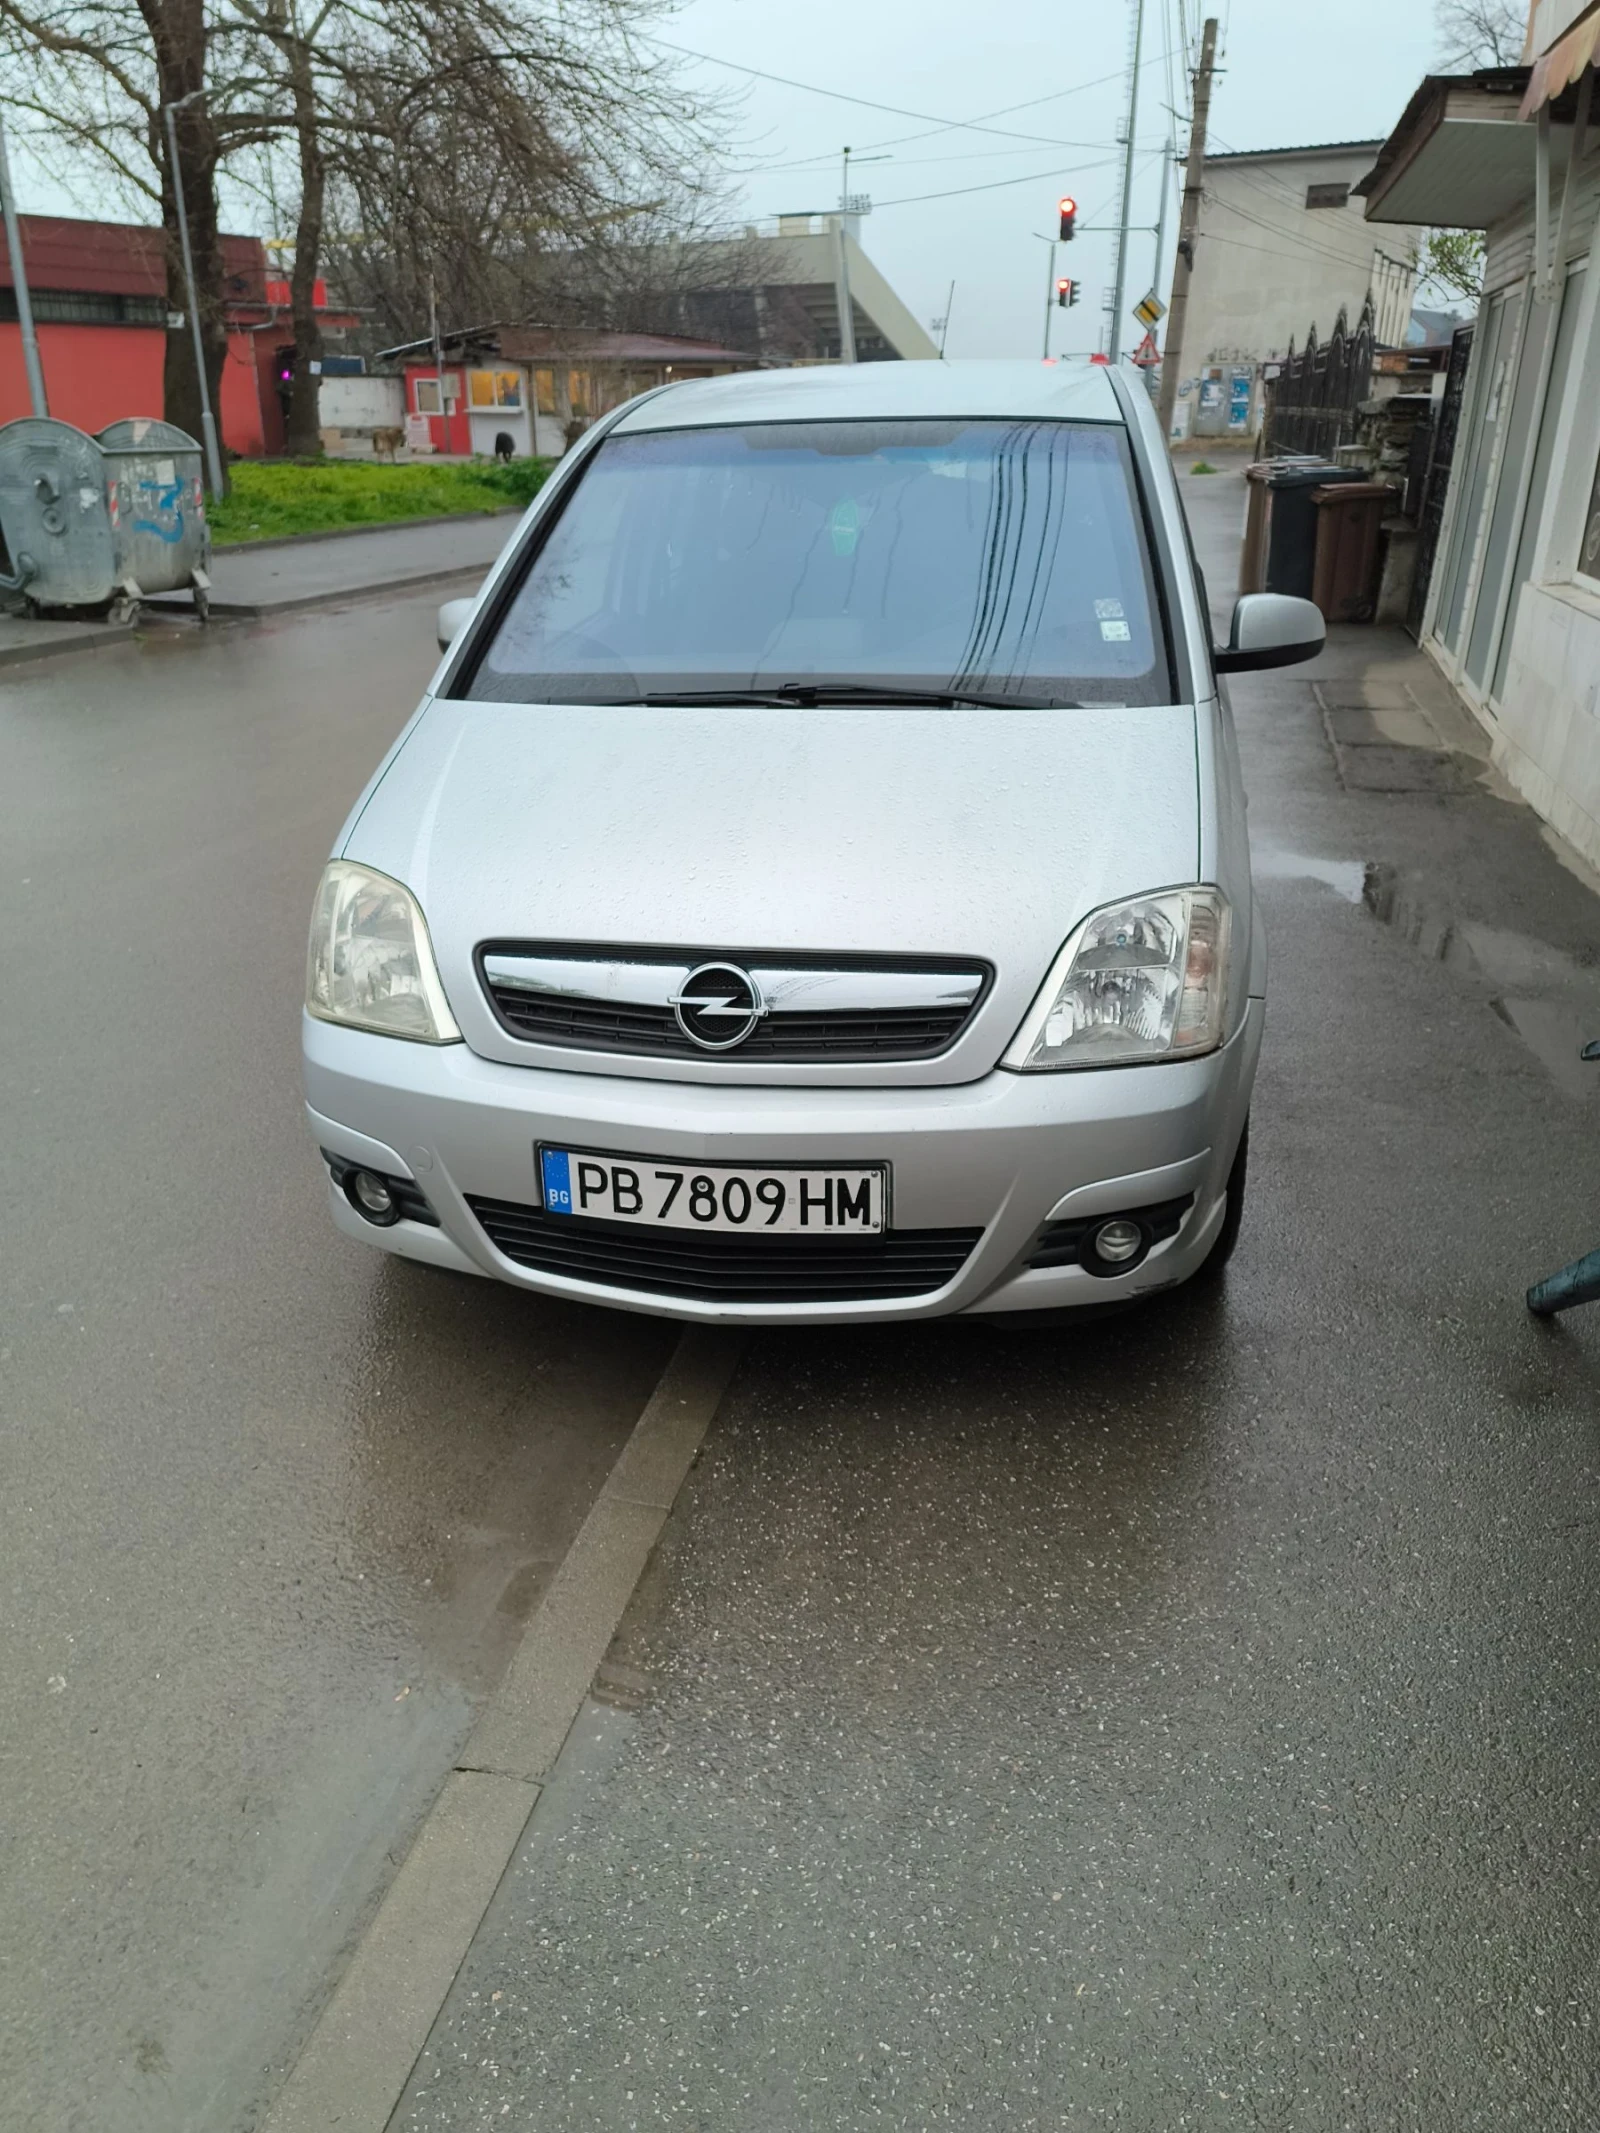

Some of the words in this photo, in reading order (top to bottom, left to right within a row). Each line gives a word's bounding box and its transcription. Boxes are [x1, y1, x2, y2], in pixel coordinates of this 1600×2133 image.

[548, 1188, 569, 1204] BG
[577, 1161, 643, 1215] PB
[654, 1171, 786, 1225] 7809
[799, 1178, 871, 1226] HM
